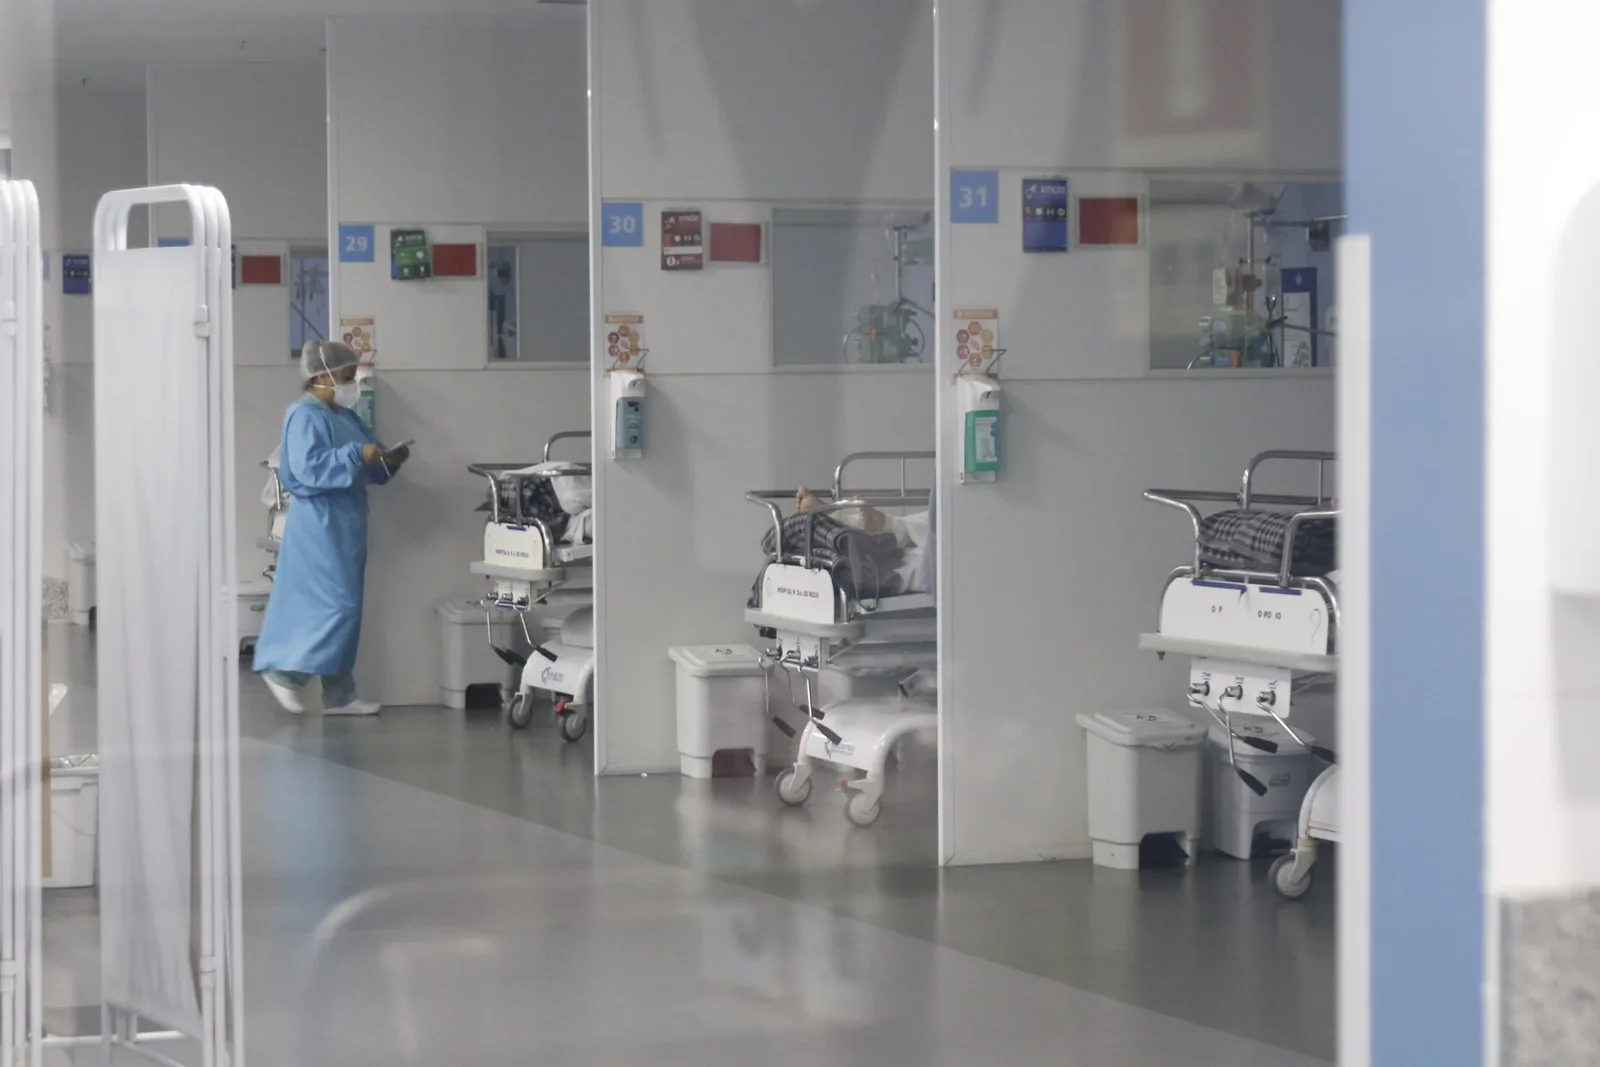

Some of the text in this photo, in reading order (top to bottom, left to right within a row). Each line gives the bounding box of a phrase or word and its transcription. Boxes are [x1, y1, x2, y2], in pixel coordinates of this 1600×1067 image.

[959, 186, 987, 208] 31
[608, 215, 635, 233] 30
[345, 236, 367, 251] 29
